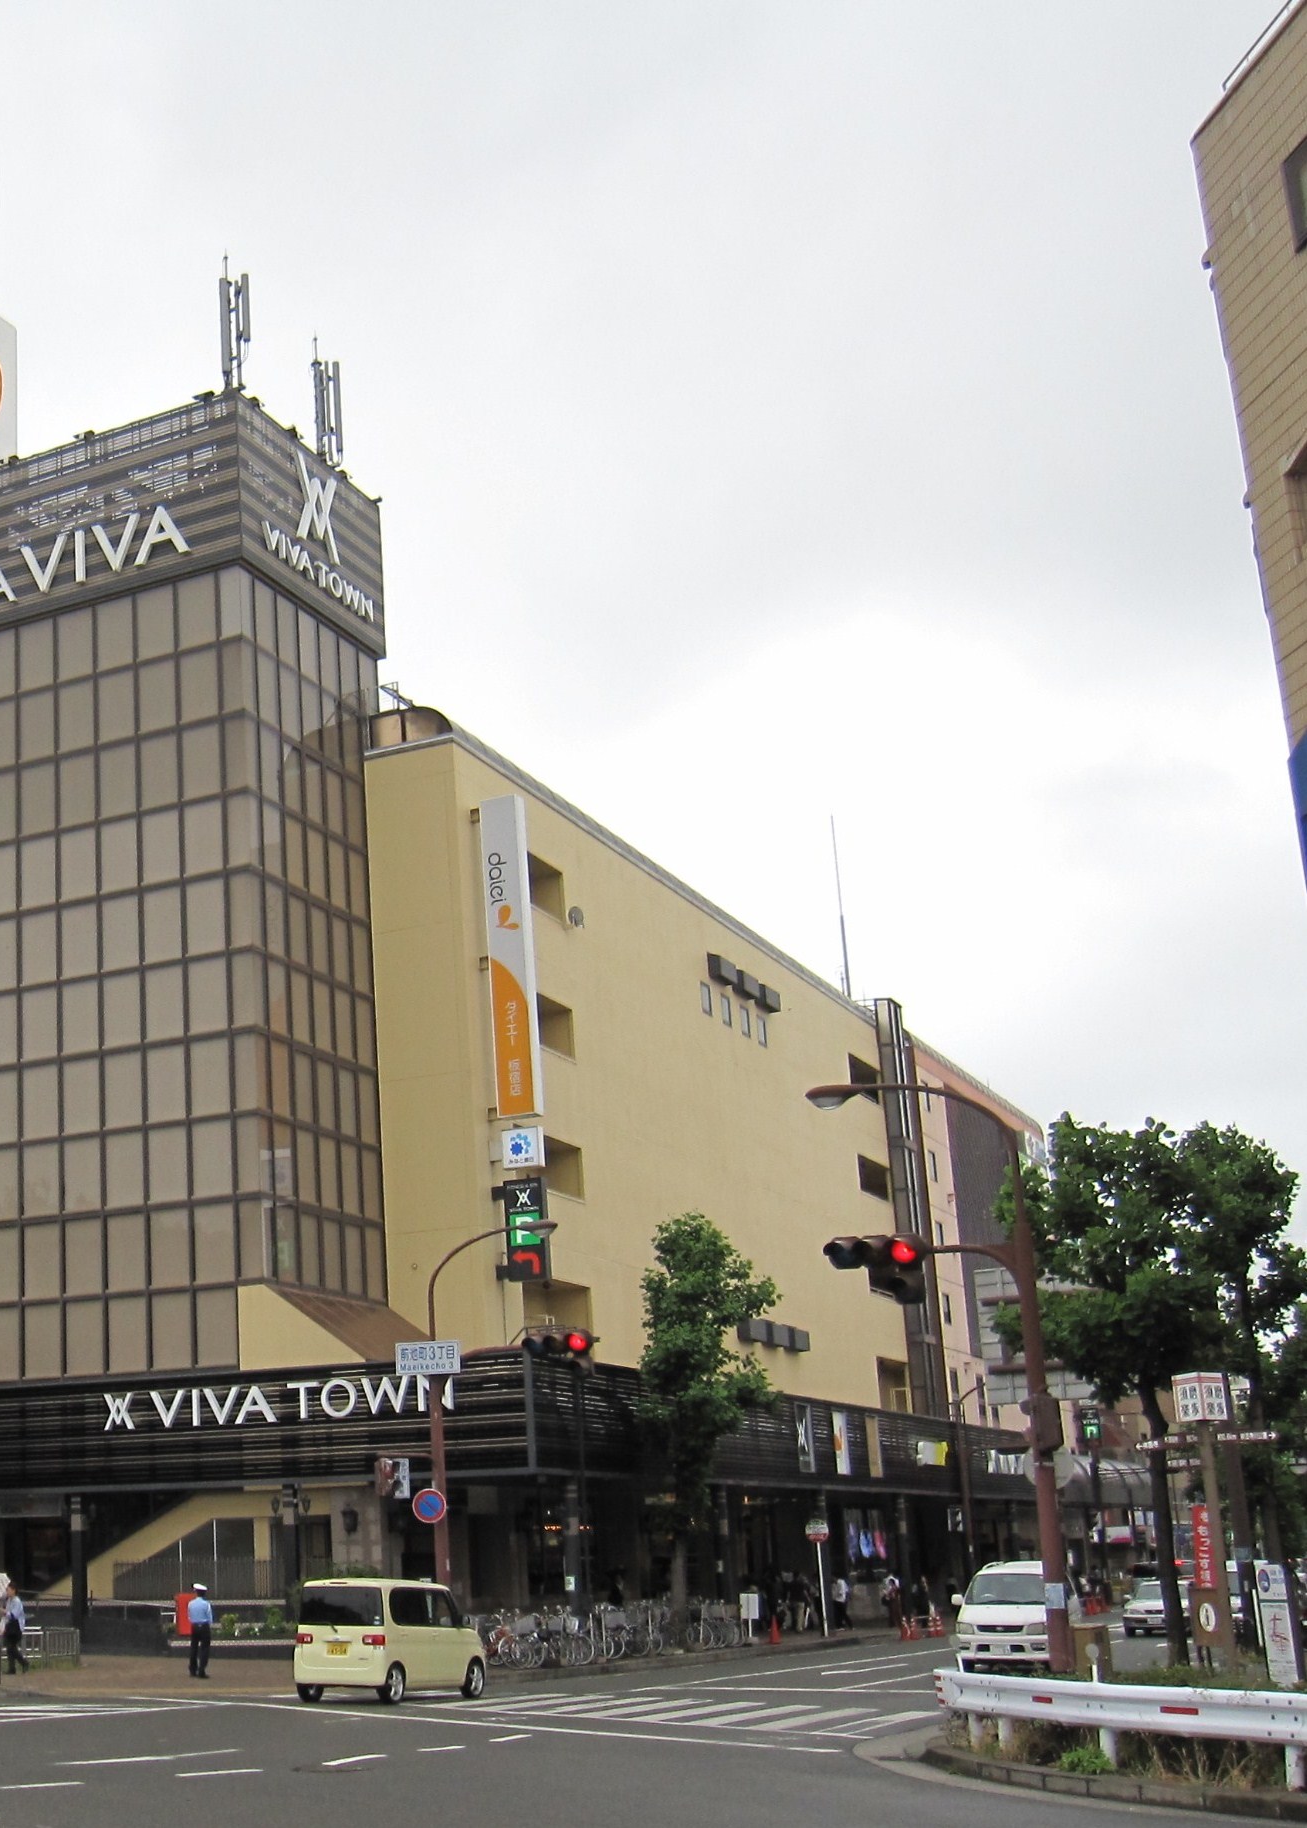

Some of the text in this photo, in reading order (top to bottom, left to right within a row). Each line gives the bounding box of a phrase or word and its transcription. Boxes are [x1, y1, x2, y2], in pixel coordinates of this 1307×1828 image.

[21, 505, 192, 594] VIVA
[261, 520, 374, 622] VIVA TOWN
[487, 852, 507, 905] daiei
[504, 1001, 518, 1047] ダイエー
[399, 1361, 454, 1372] Maeikecho 3
[400, 1345, 455, 1361] 前池町3丁目
[149, 1374, 455, 1429] VIVA TOWN
